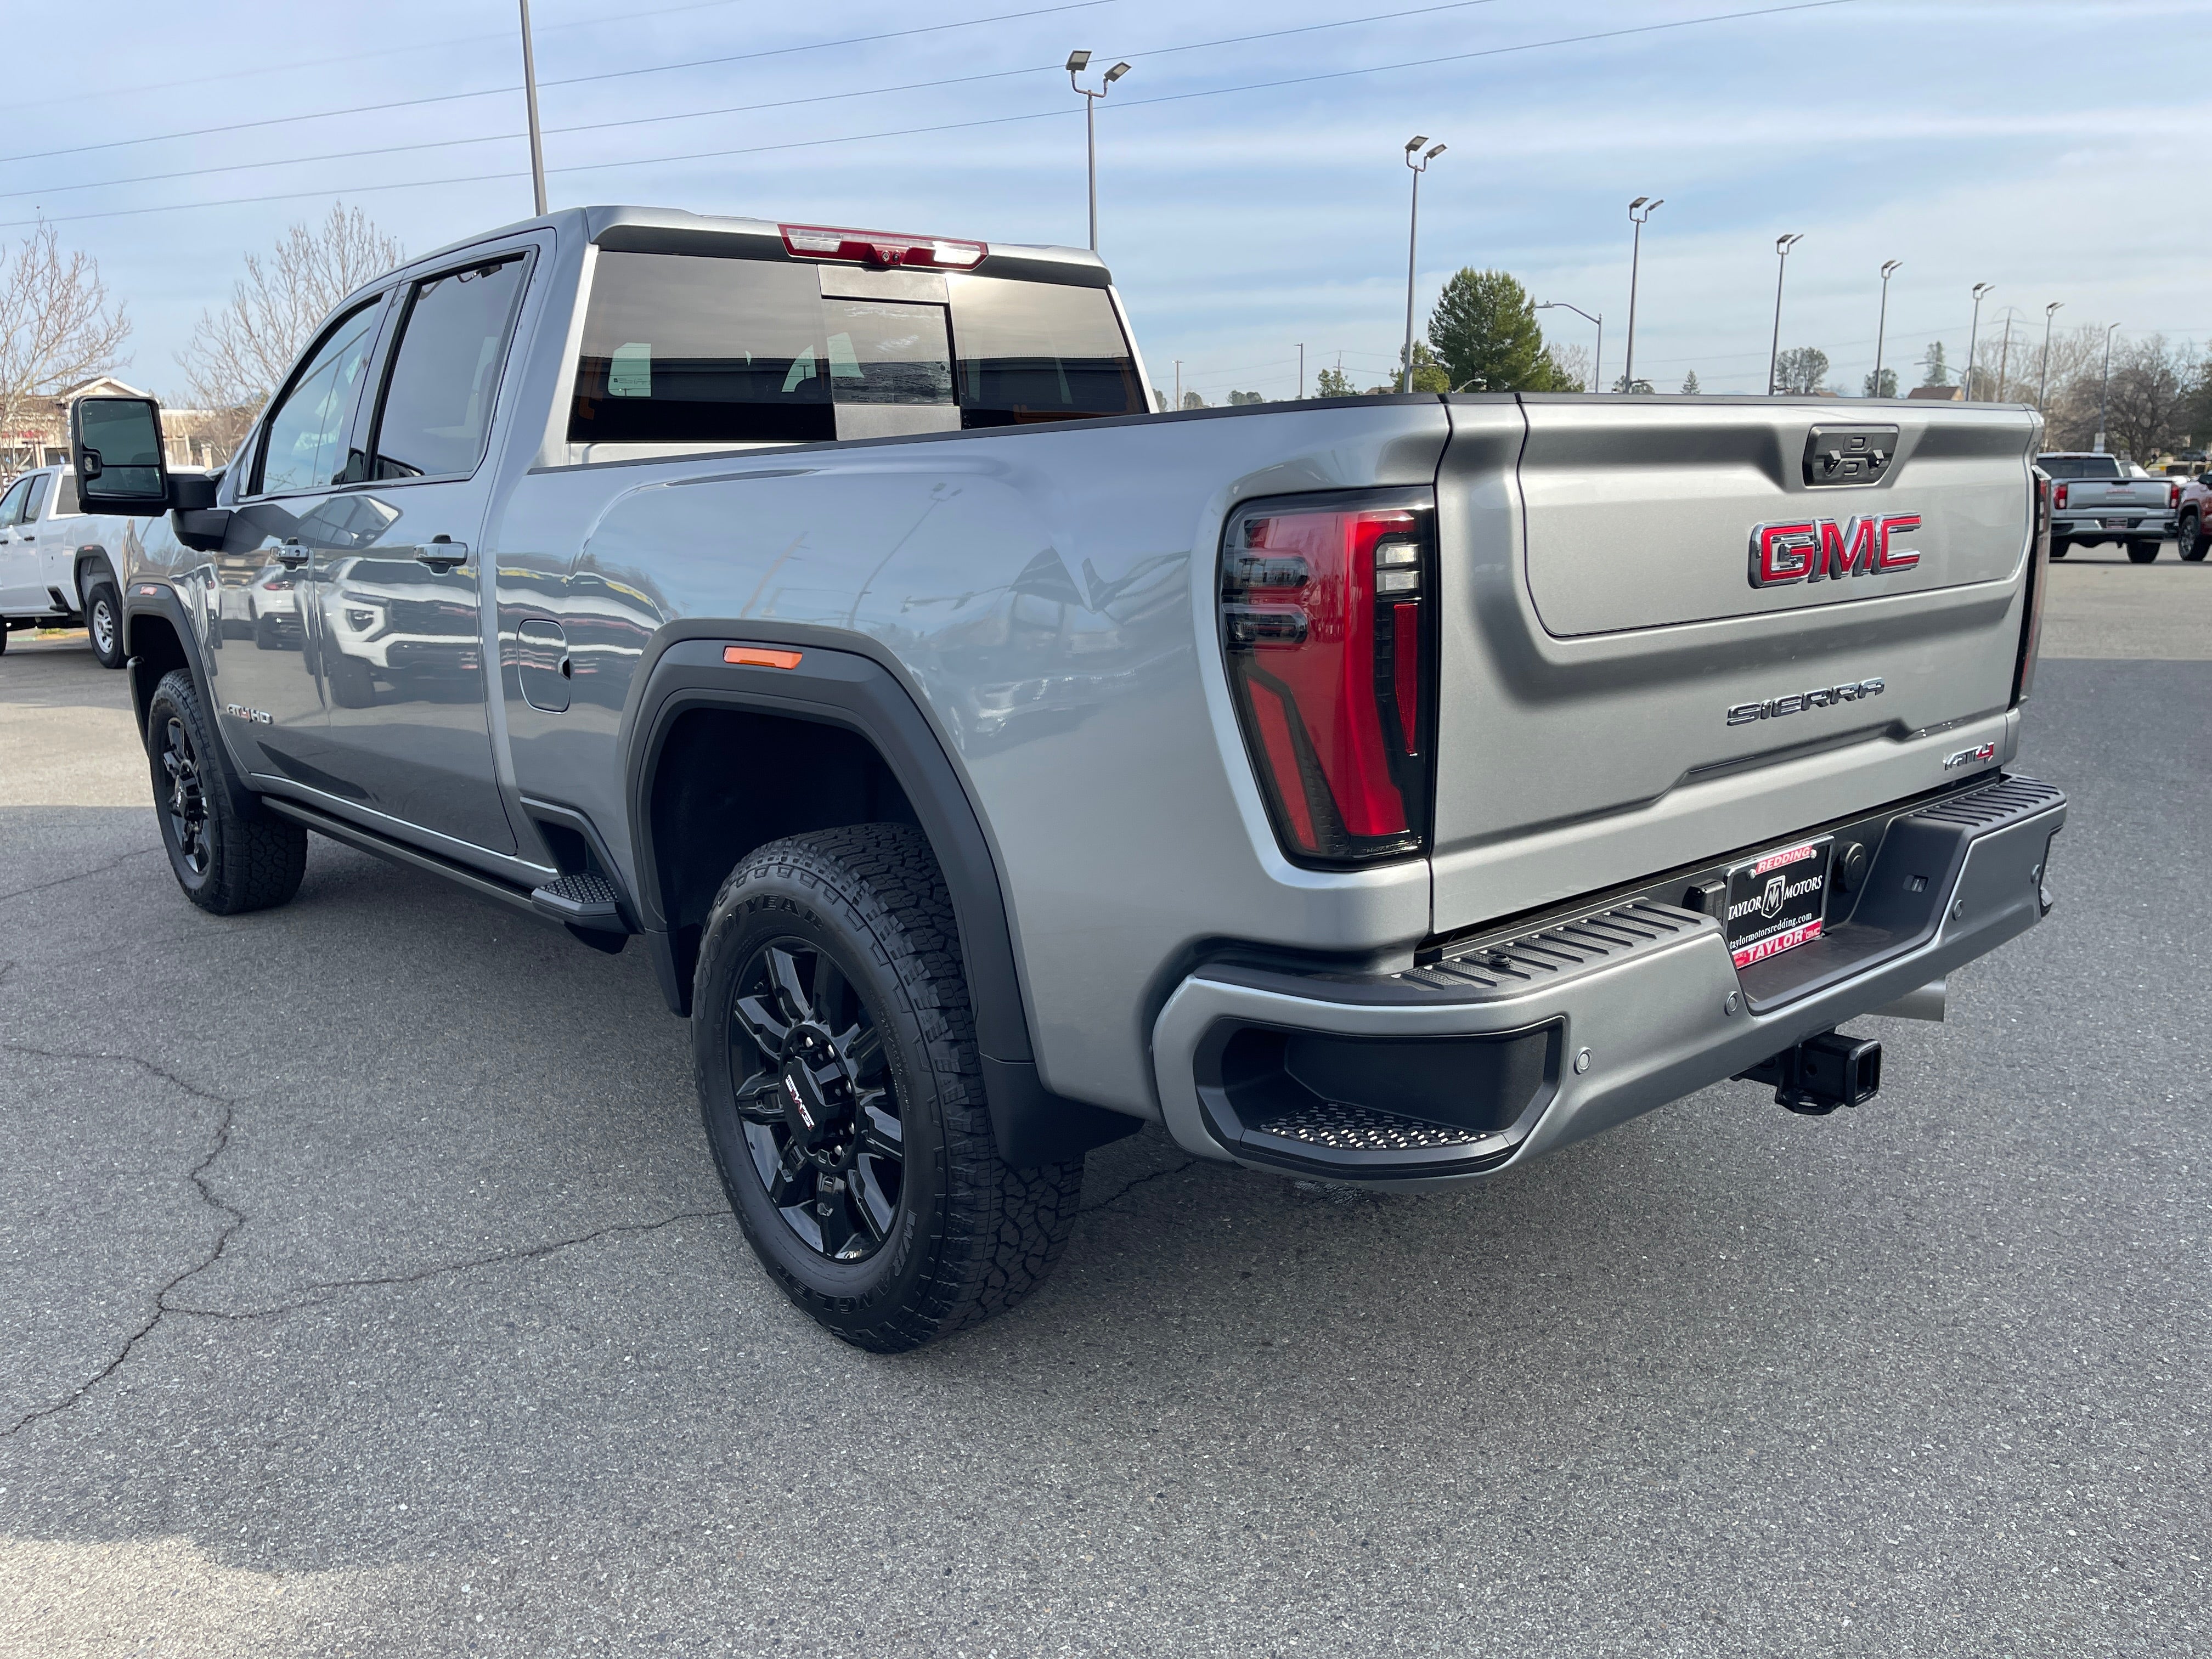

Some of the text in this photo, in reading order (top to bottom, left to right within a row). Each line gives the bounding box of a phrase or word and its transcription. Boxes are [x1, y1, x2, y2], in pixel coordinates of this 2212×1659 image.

[1748, 512, 1921, 589] GMC
[1727, 677, 1884, 726] SIERRA
[1942, 741, 1995, 772] AT4
[1758, 847, 1810, 872] REDDING
[1728, 896, 1762, 921] TAYLOR
[1784, 874, 1823, 900] MOTORS
[1730, 912, 1812, 950] taylormotorsredding.com
[1747, 929, 1803, 962] TAYLOR
[1805, 927, 1821, 940] GMC
[785, 1073, 815, 1132] GMC
